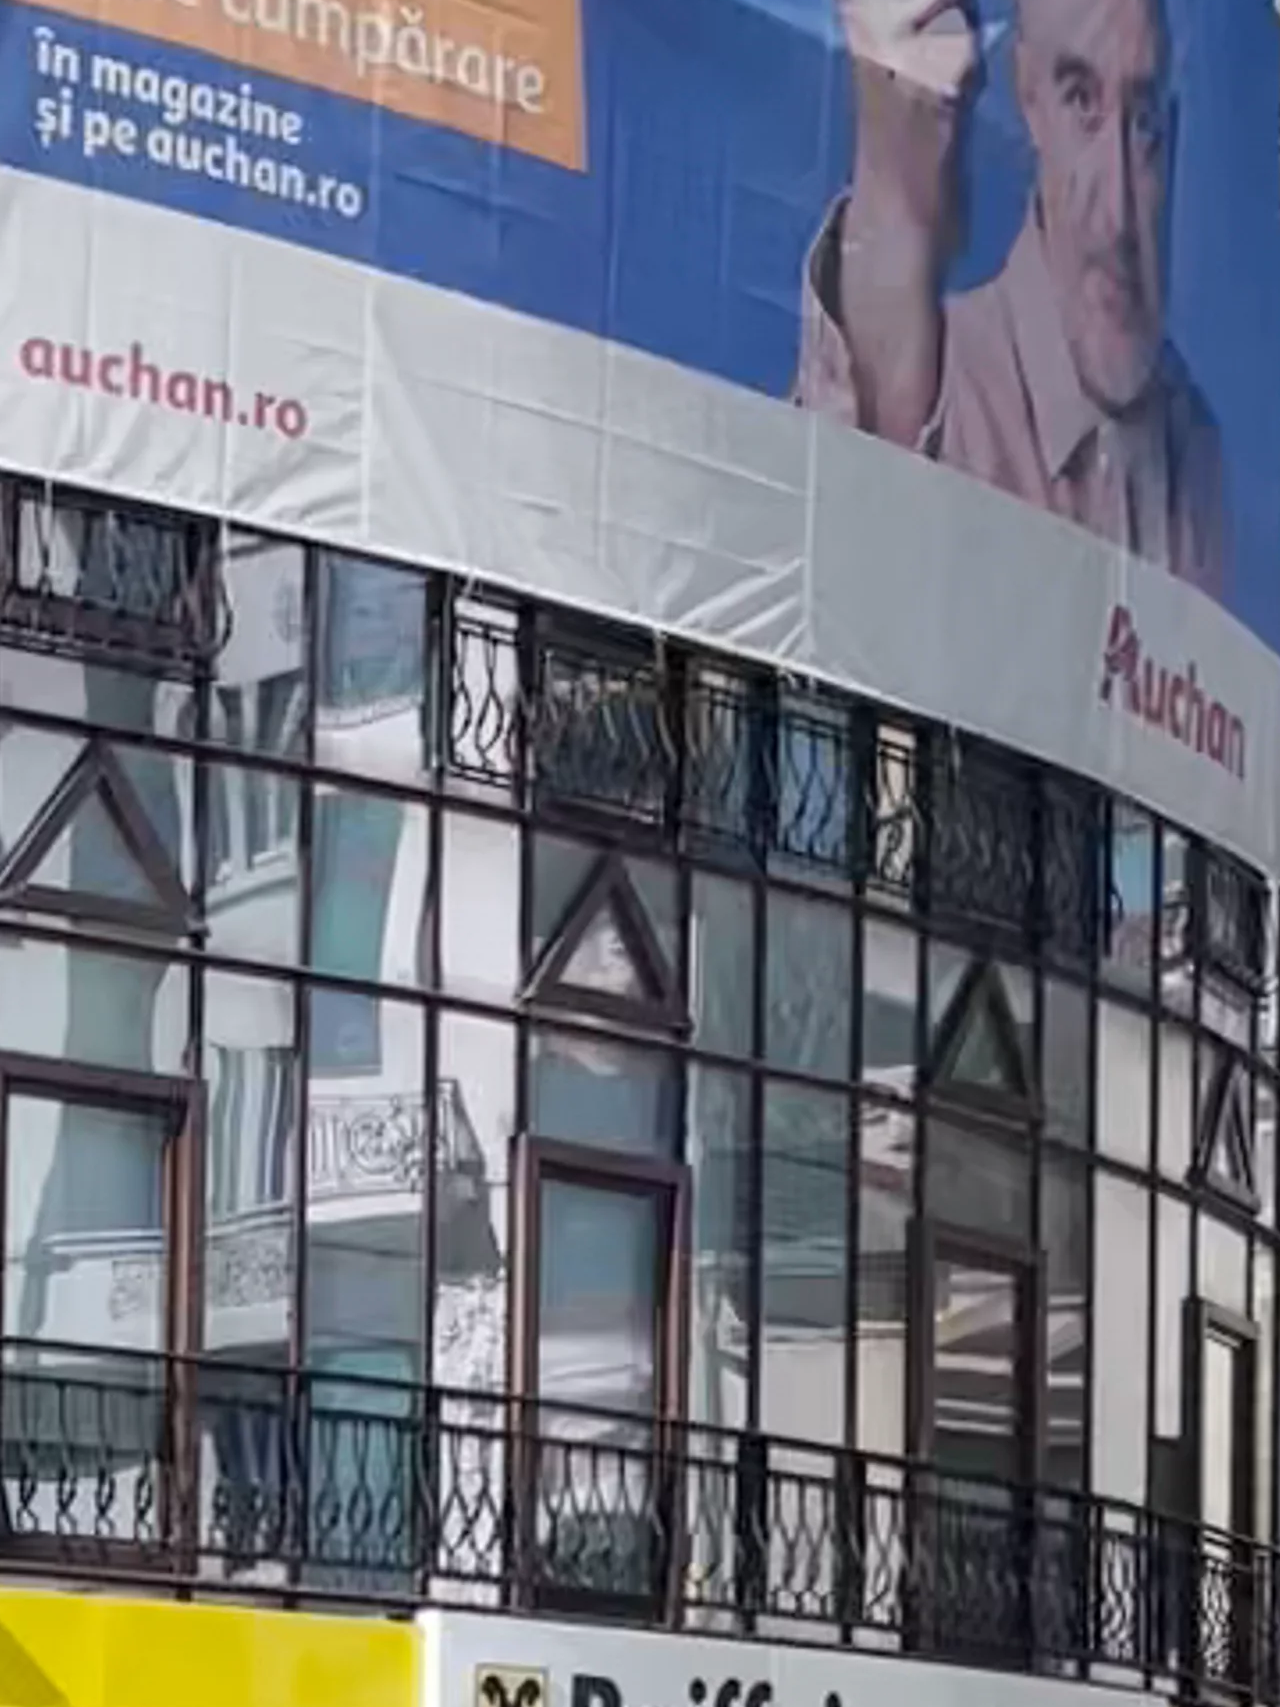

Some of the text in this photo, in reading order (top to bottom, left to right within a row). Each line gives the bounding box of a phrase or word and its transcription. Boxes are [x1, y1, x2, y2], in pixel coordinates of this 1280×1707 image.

[34, 25, 305, 146] în magazine
[82, 105, 138, 157] pe
[146, 123, 365, 218] auchan.ro
[19, 334, 310, 440] auchan.ro
[1099, 604, 1246, 782] Auchan
